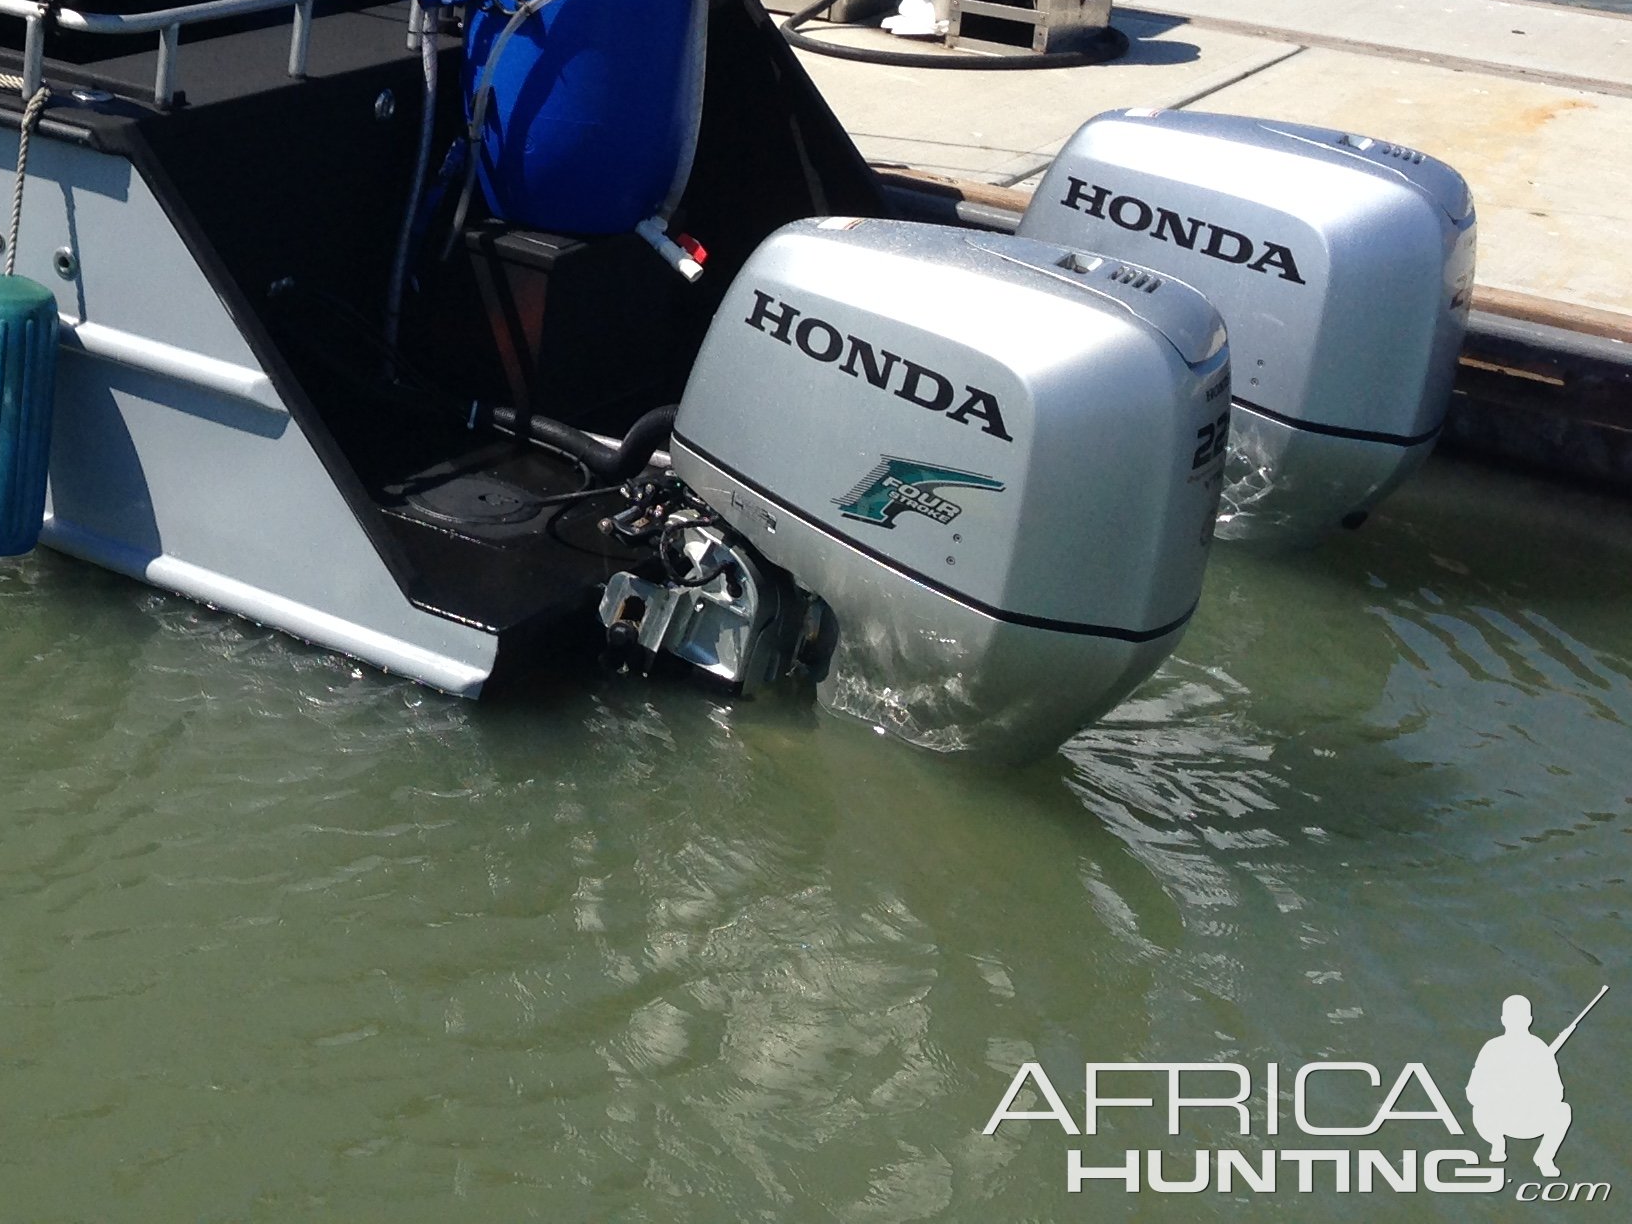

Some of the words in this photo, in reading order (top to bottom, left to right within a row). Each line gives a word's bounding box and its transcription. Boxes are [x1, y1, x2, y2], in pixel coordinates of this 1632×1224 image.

[1059, 175, 1306, 286] HONDA
[744, 289, 1014, 444] HONDA
[881, 475, 962, 520] FOUR
[887, 490, 952, 525] STROKE
